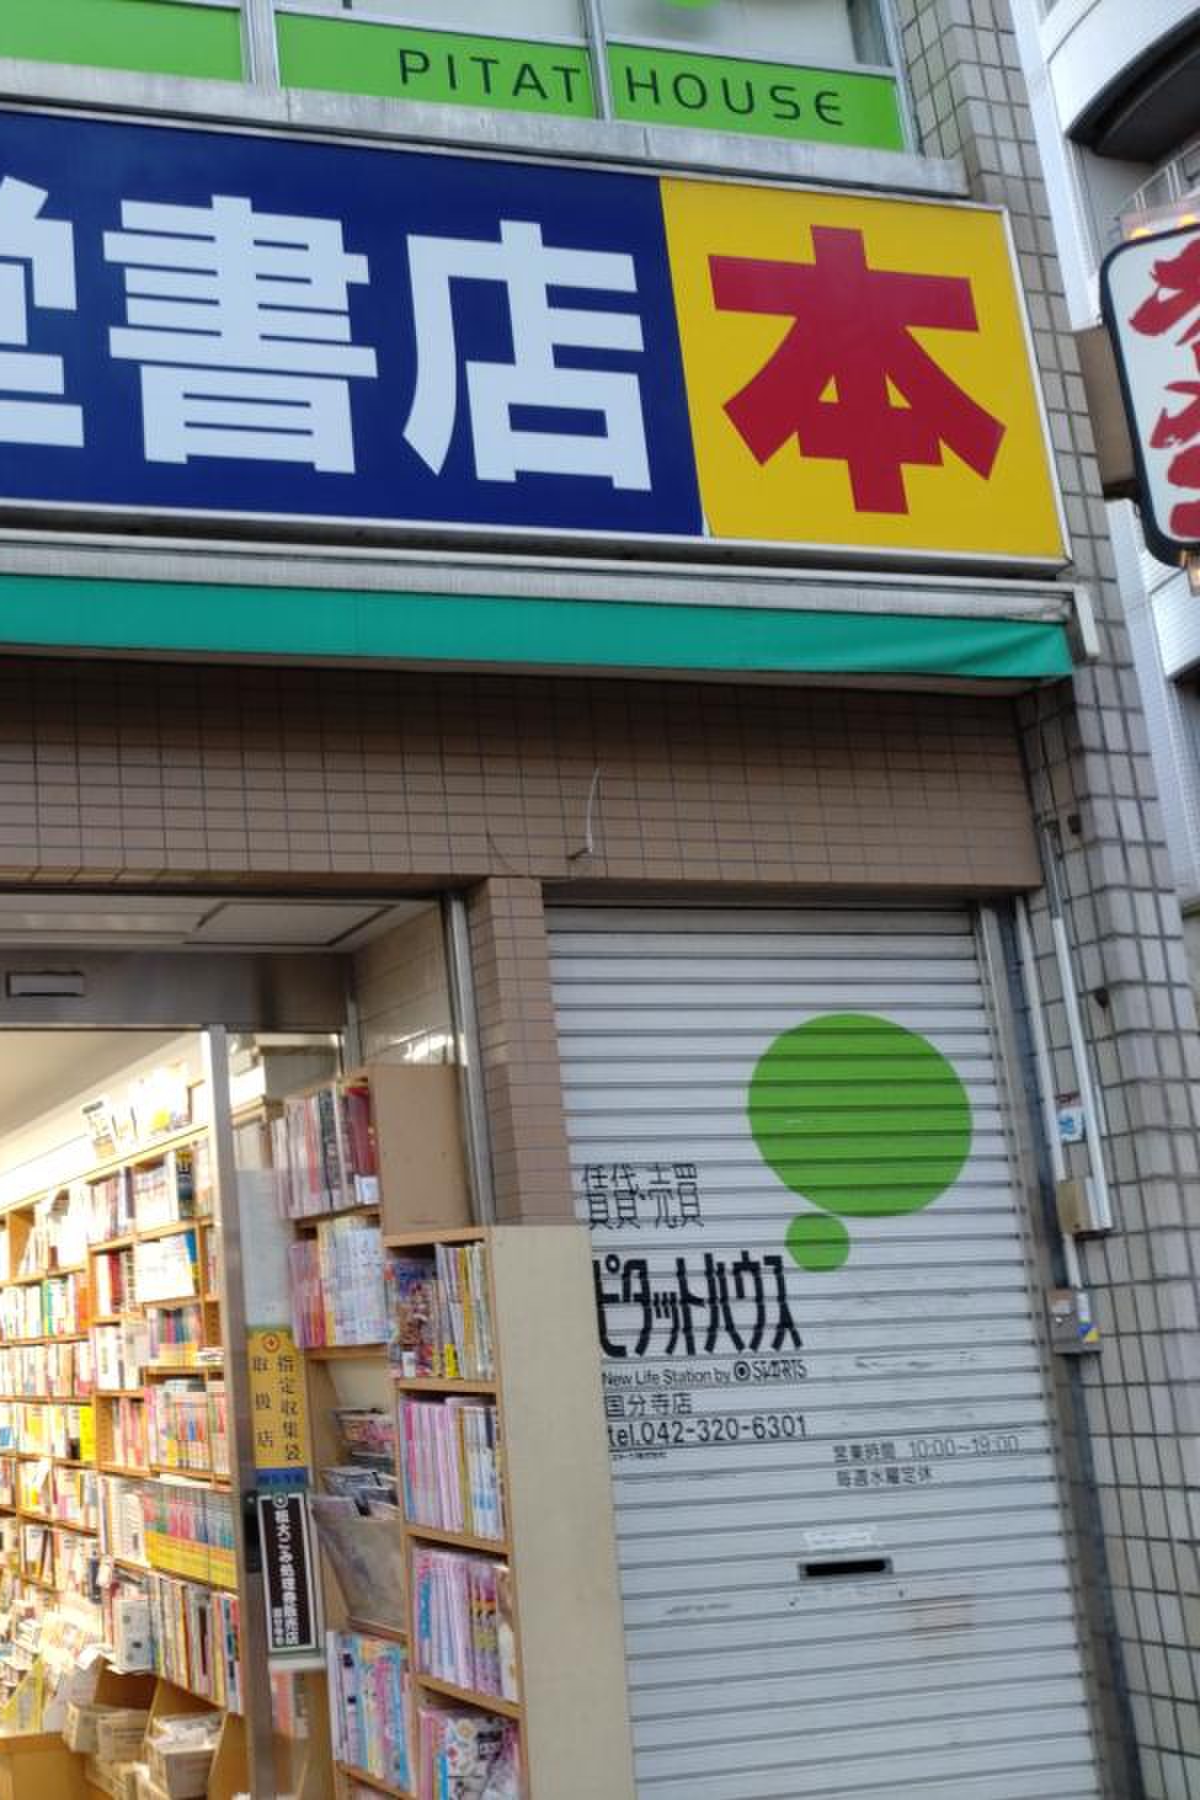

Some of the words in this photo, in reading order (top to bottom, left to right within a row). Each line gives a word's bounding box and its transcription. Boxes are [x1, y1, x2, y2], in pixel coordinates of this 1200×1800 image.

[398, 48, 582, 103] PITAT
[623, 66, 845, 127] HOUSE
[707, 224, 1007, 516] 本
[592, 1250, 804, 1358] ピタットハウス
[634, 1370, 660, 1386] Life
[663, 1367, 712, 1386] Station
[714, 1366, 731, 1382] by
[605, 1391, 693, 1418] 国分寺店
[608, 1414, 807, 1447] tel.042-320-6301
